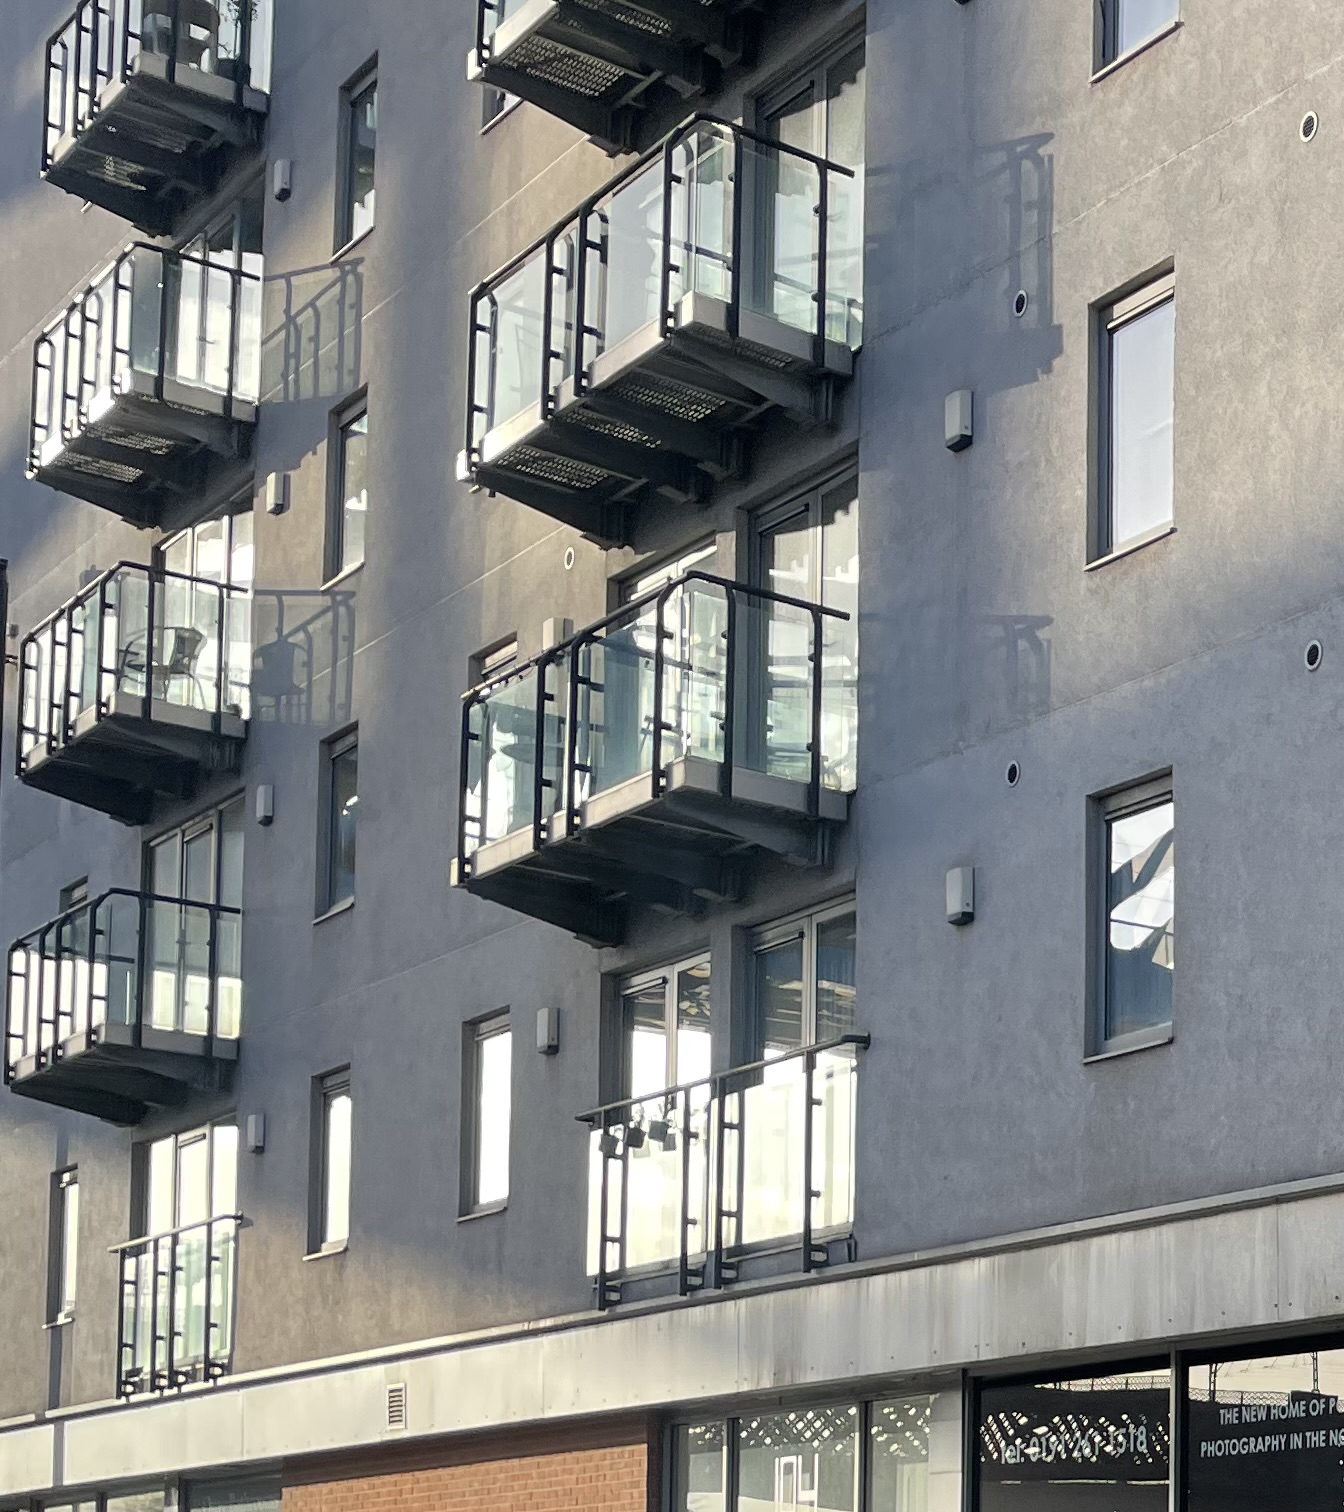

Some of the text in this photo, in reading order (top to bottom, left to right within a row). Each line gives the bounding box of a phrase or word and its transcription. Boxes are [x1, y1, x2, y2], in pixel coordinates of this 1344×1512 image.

[1219, 1406, 1239, 1426] THE
[1242, 1404, 1267, 1424] NEW
[1270, 1400, 1306, 1421] HOME
[1309, 1398, 1326, 1417] OF
[1200, 1433, 1287, 1458] PHOTOGRAPHY
[1290, 1432, 1303, 1450] IN
[1305, 1430, 1326, 1449] THE
